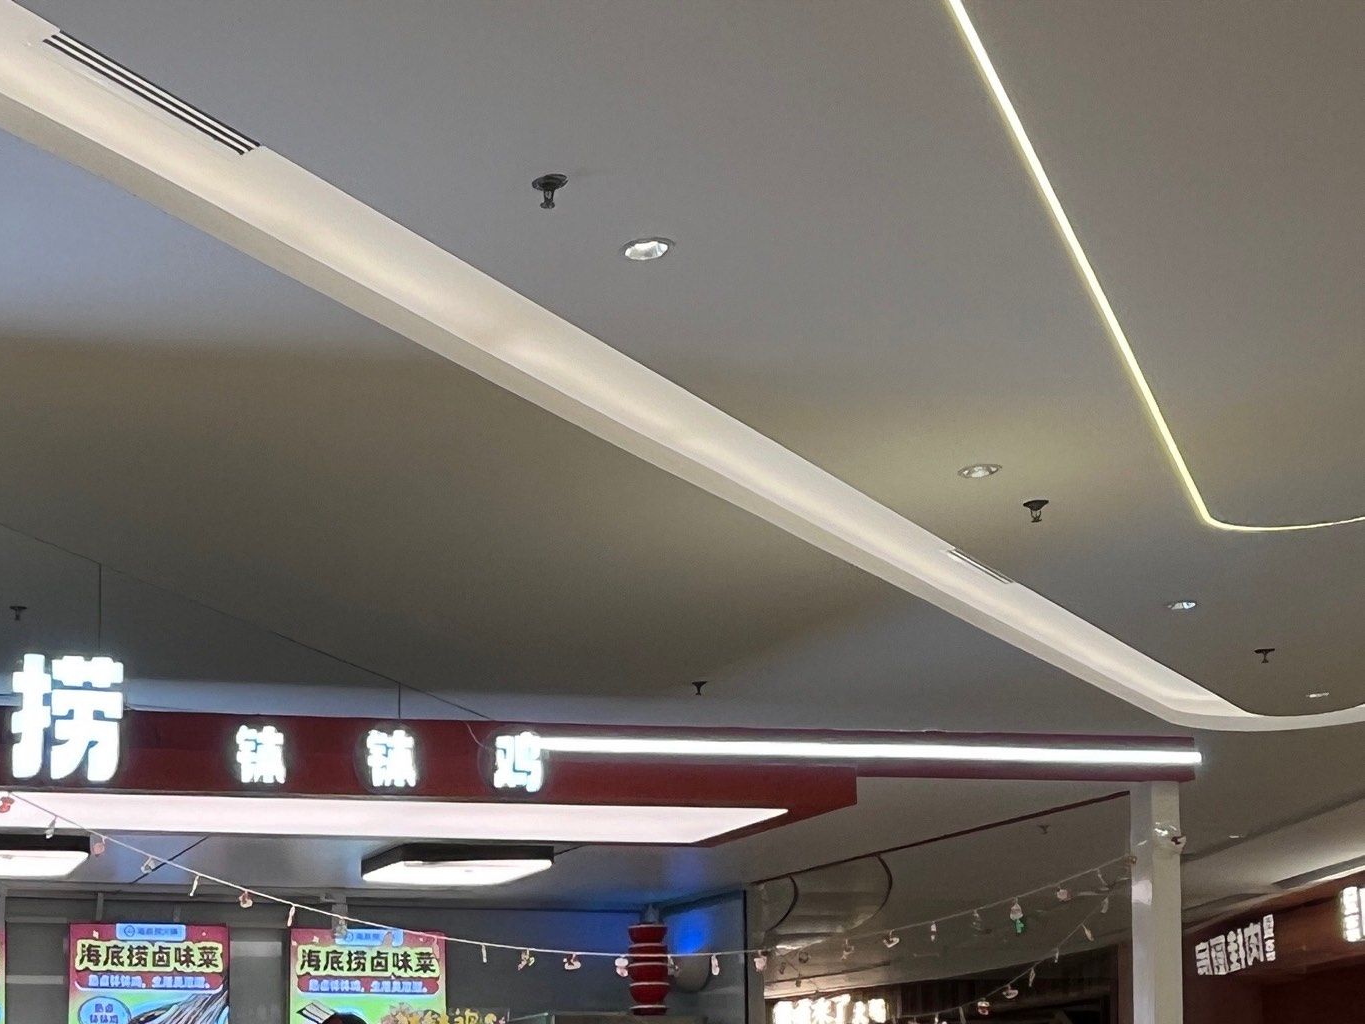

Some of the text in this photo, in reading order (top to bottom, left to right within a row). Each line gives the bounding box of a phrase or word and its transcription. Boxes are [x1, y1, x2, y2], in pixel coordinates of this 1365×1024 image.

[79, 943, 220, 968] 海底捞卤味菜
[299, 949, 436, 973] 海底捞卤味菜
